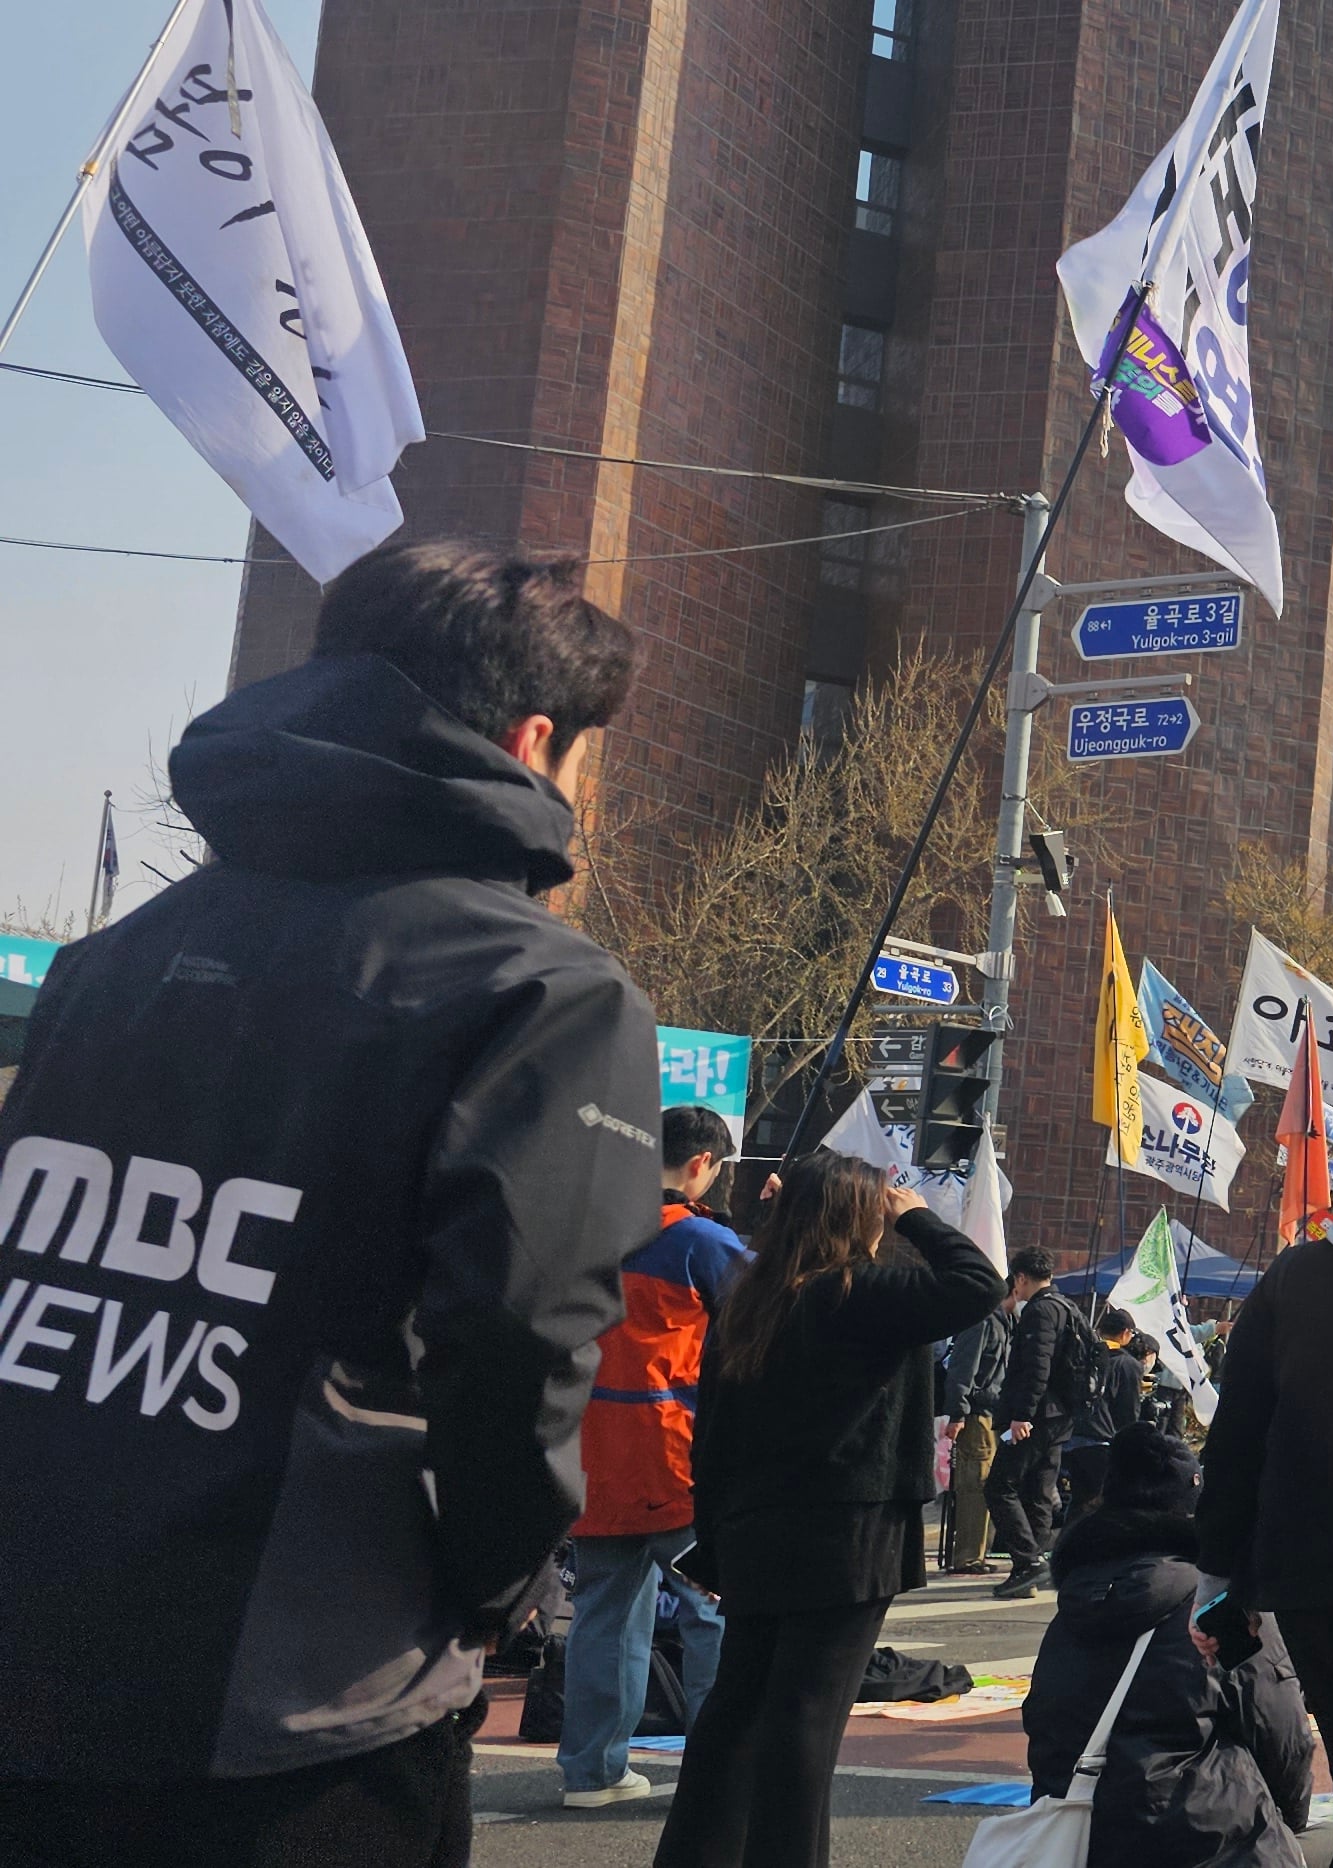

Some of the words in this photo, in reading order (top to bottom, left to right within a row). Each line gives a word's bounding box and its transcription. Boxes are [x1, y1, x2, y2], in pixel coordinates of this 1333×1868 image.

[135, 228, 184, 284] 아름답지
[175, 280, 207, 311] 못한
[245, 359, 273, 389] 길을
[1143, 598, 1237, 631] 율곡로3길
[1131, 632, 1199, 651] Yulgok-ro
[1201, 628, 1234, 646] 3-gil
[1076, 707, 1150, 734] 우정국로
[1074, 734, 1167, 756] Ujeongguk-ro
[898, 964, 932, 984] 율곡로
[896, 980, 932, 997] Yulgok-ro
[0, 1136, 303, 1304] MBC
